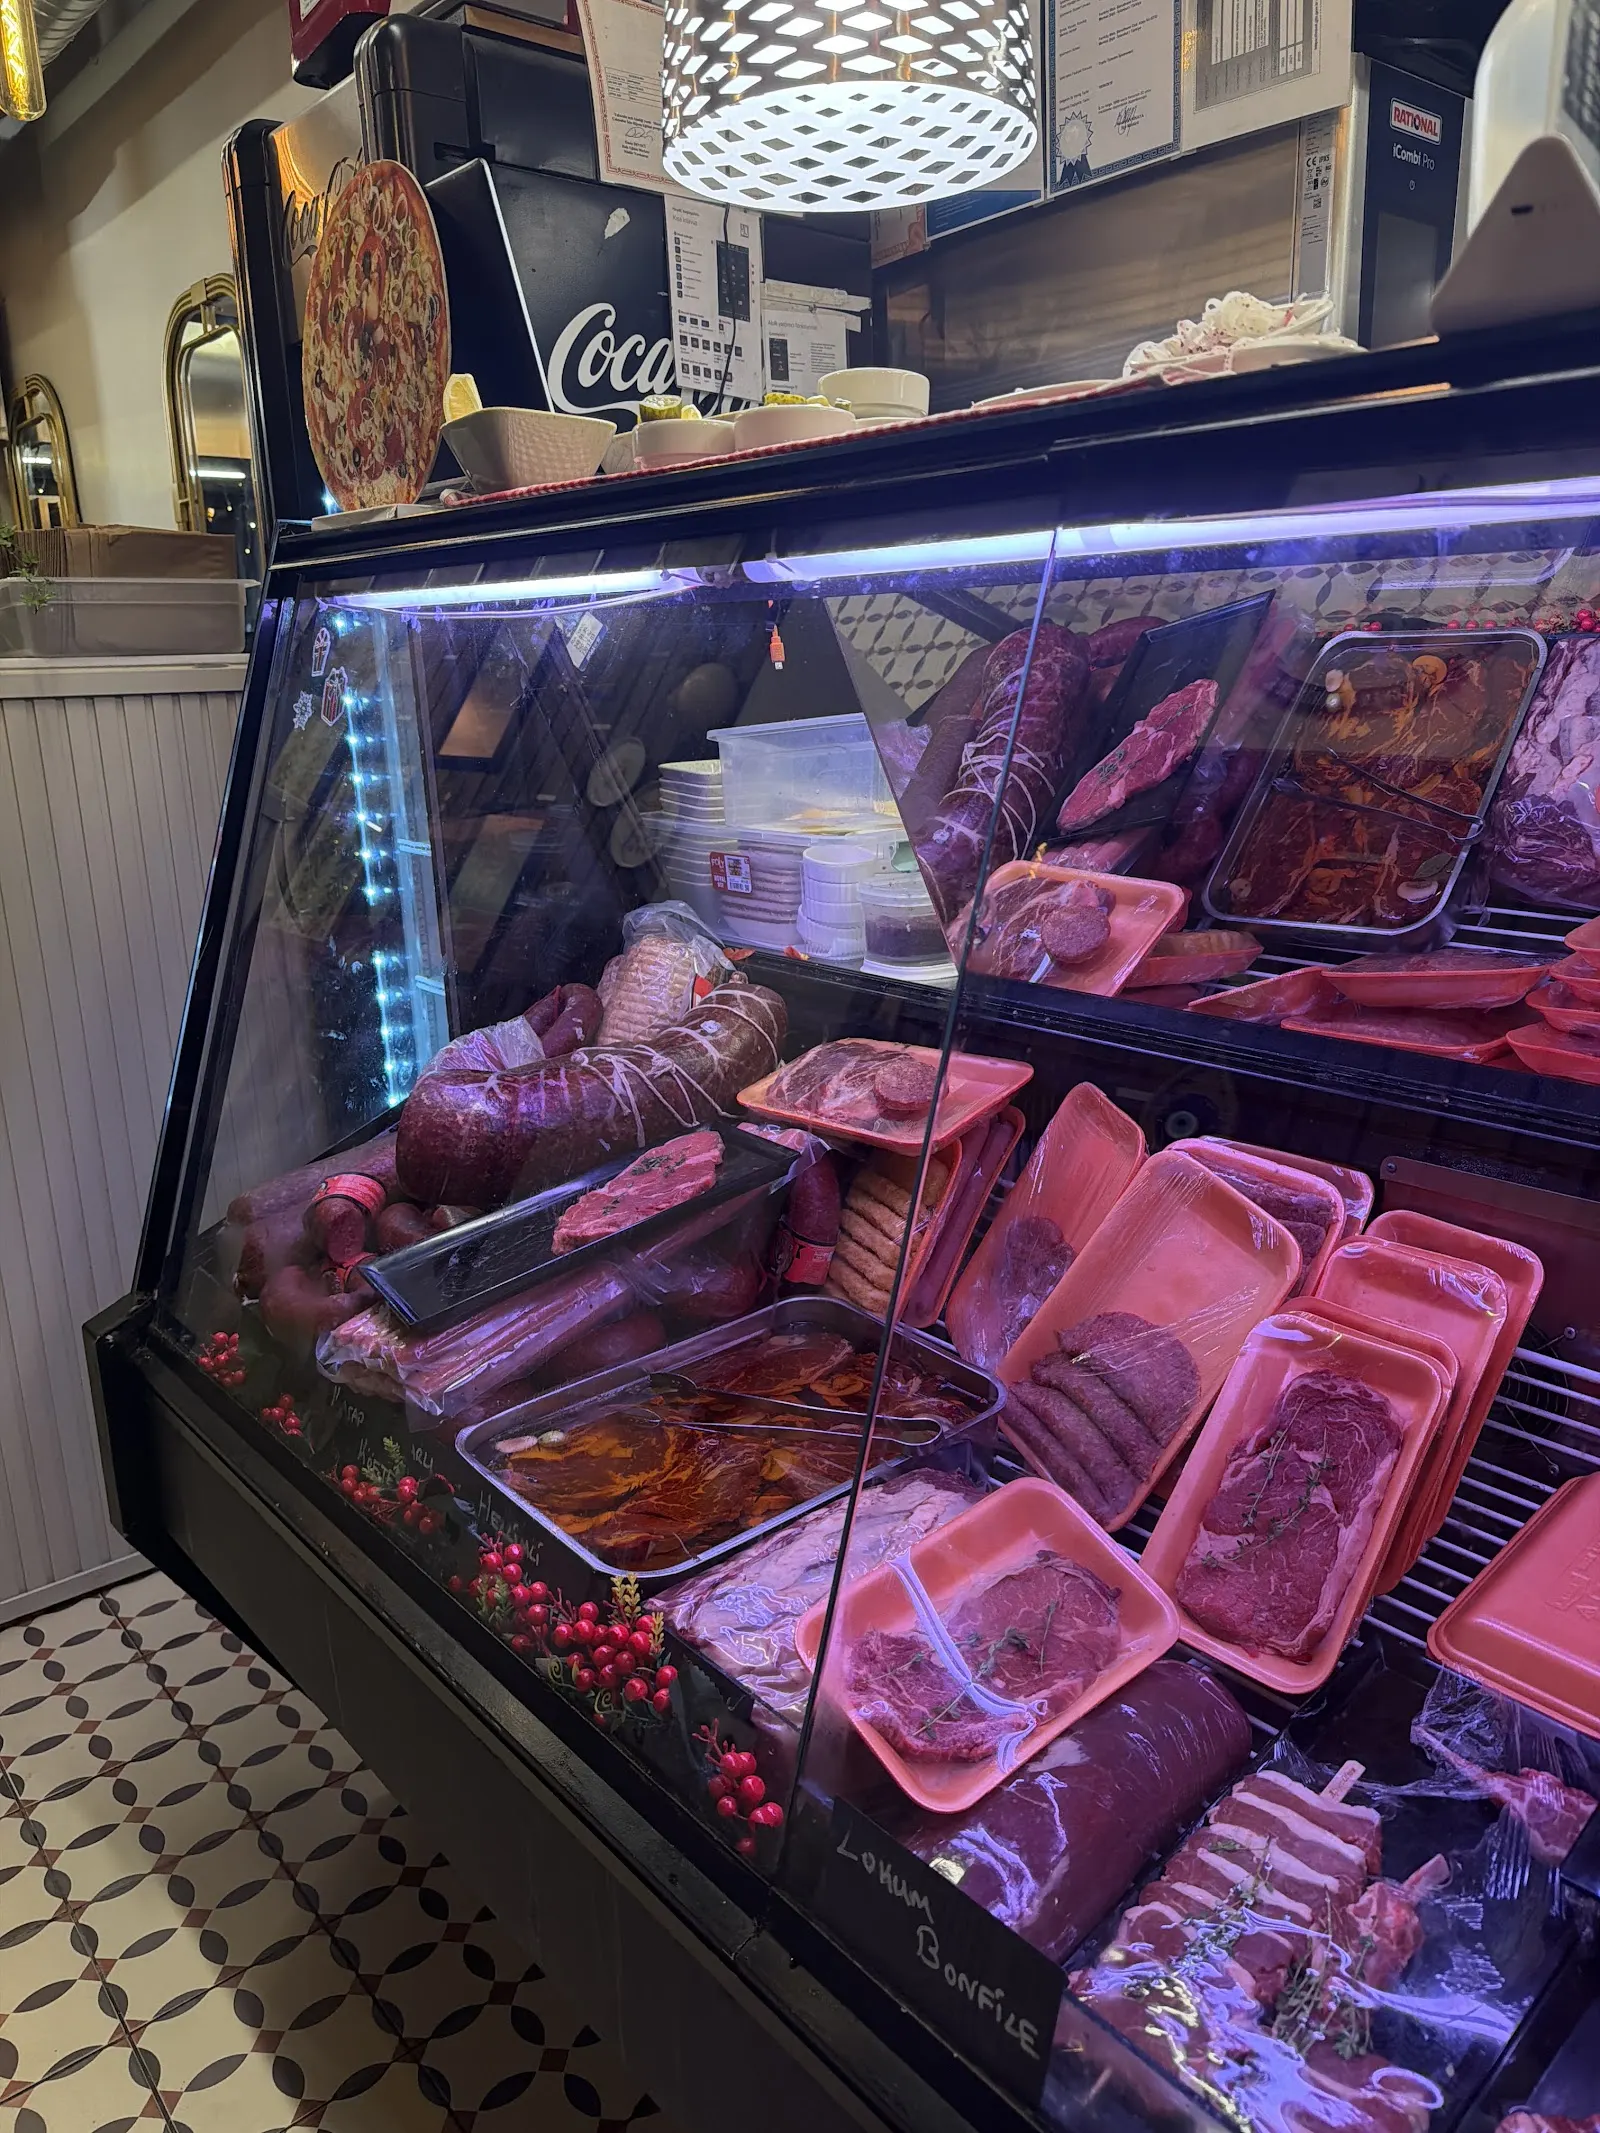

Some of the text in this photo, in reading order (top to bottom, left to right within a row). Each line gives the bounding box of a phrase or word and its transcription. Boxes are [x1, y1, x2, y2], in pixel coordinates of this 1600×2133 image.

[1393, 106, 1438, 137] RATIONAL
[1392, 142, 1435, 170] iCombi Pro
